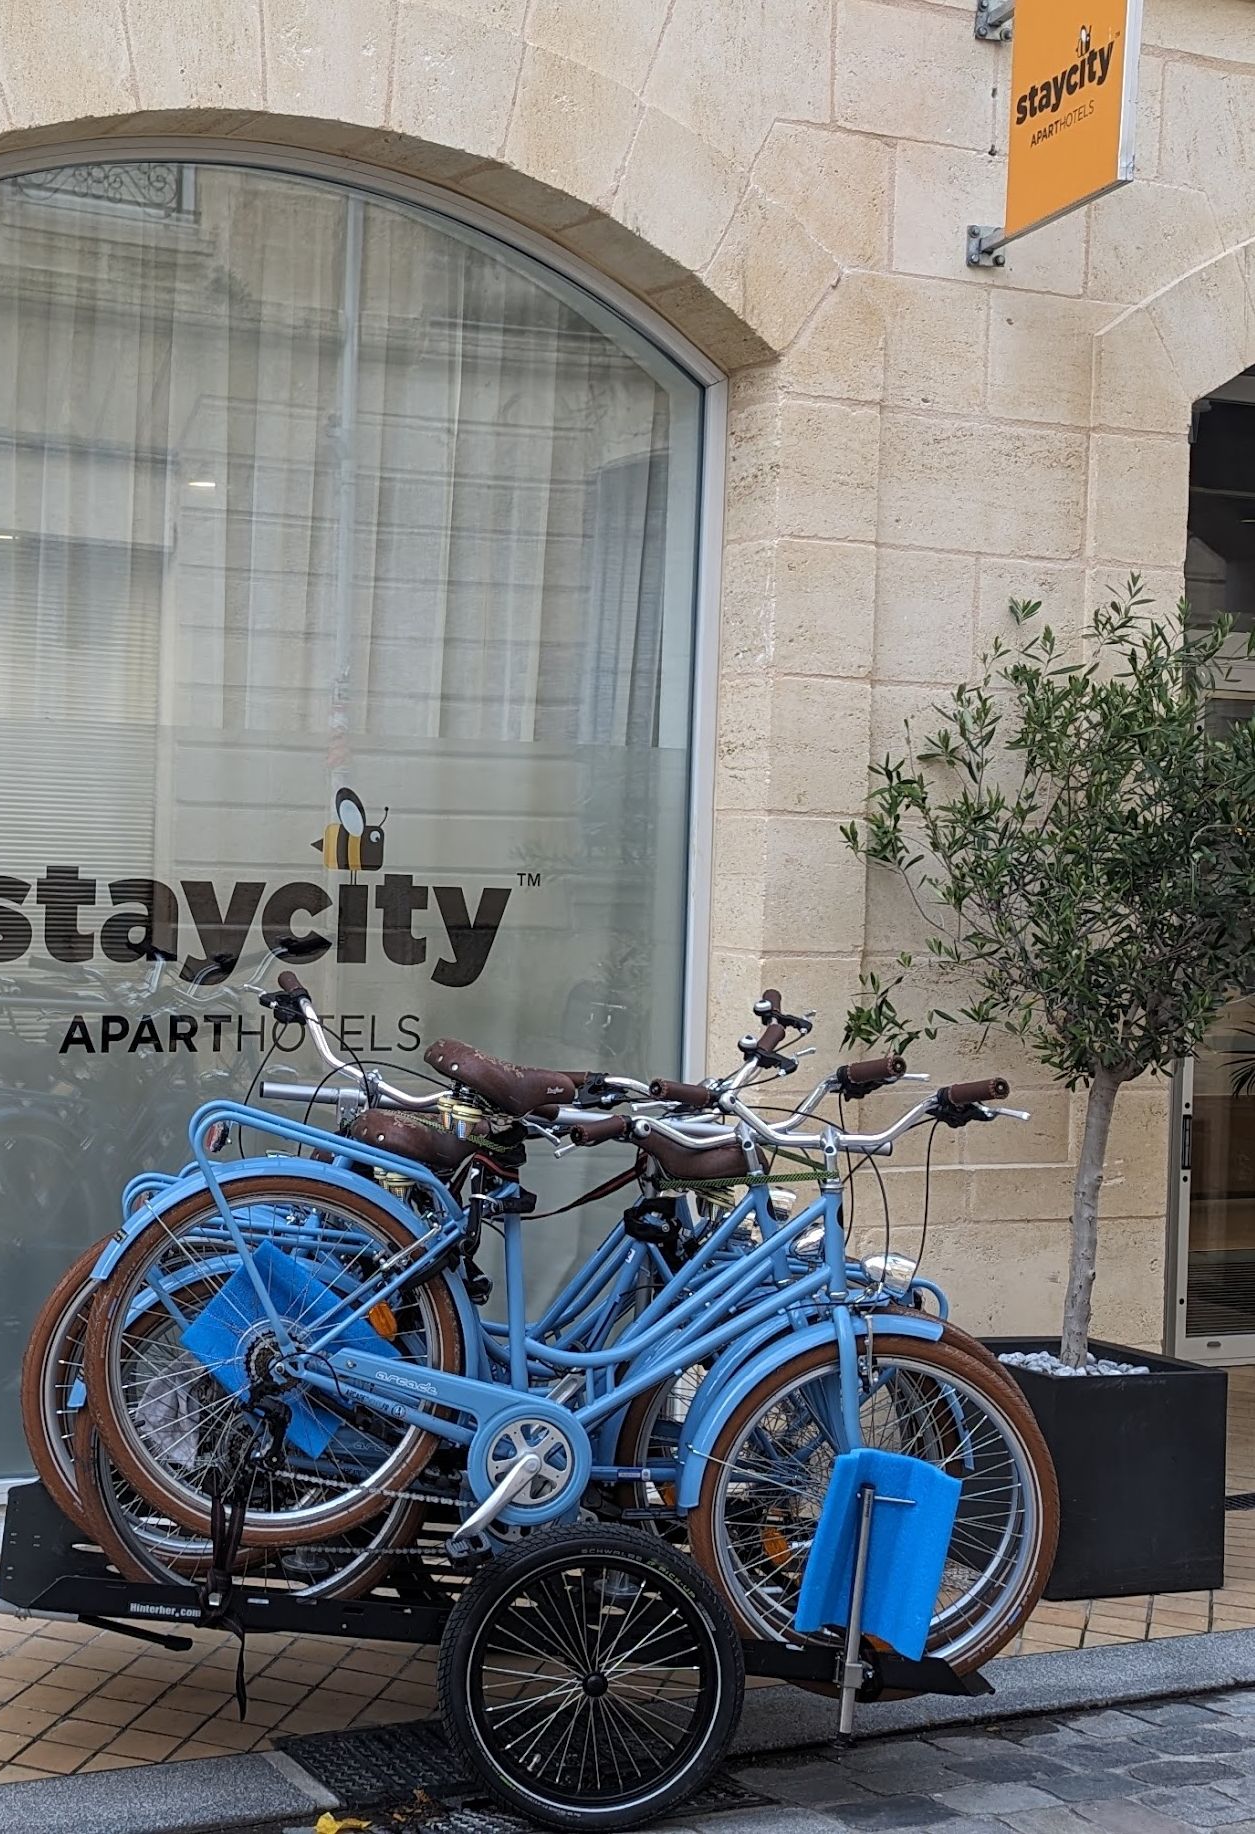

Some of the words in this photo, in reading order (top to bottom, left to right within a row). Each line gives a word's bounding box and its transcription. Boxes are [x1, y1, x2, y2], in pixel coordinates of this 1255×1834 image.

[1015, 40, 1115, 125] staycity
[1030, 100, 1095, 148] APARTHOTELS
[375, 1370, 438, 1396] arcade
[581, 1548, 642, 1562] SCHWALBE
[130, 1602, 202, 1618] Hinterher.com
